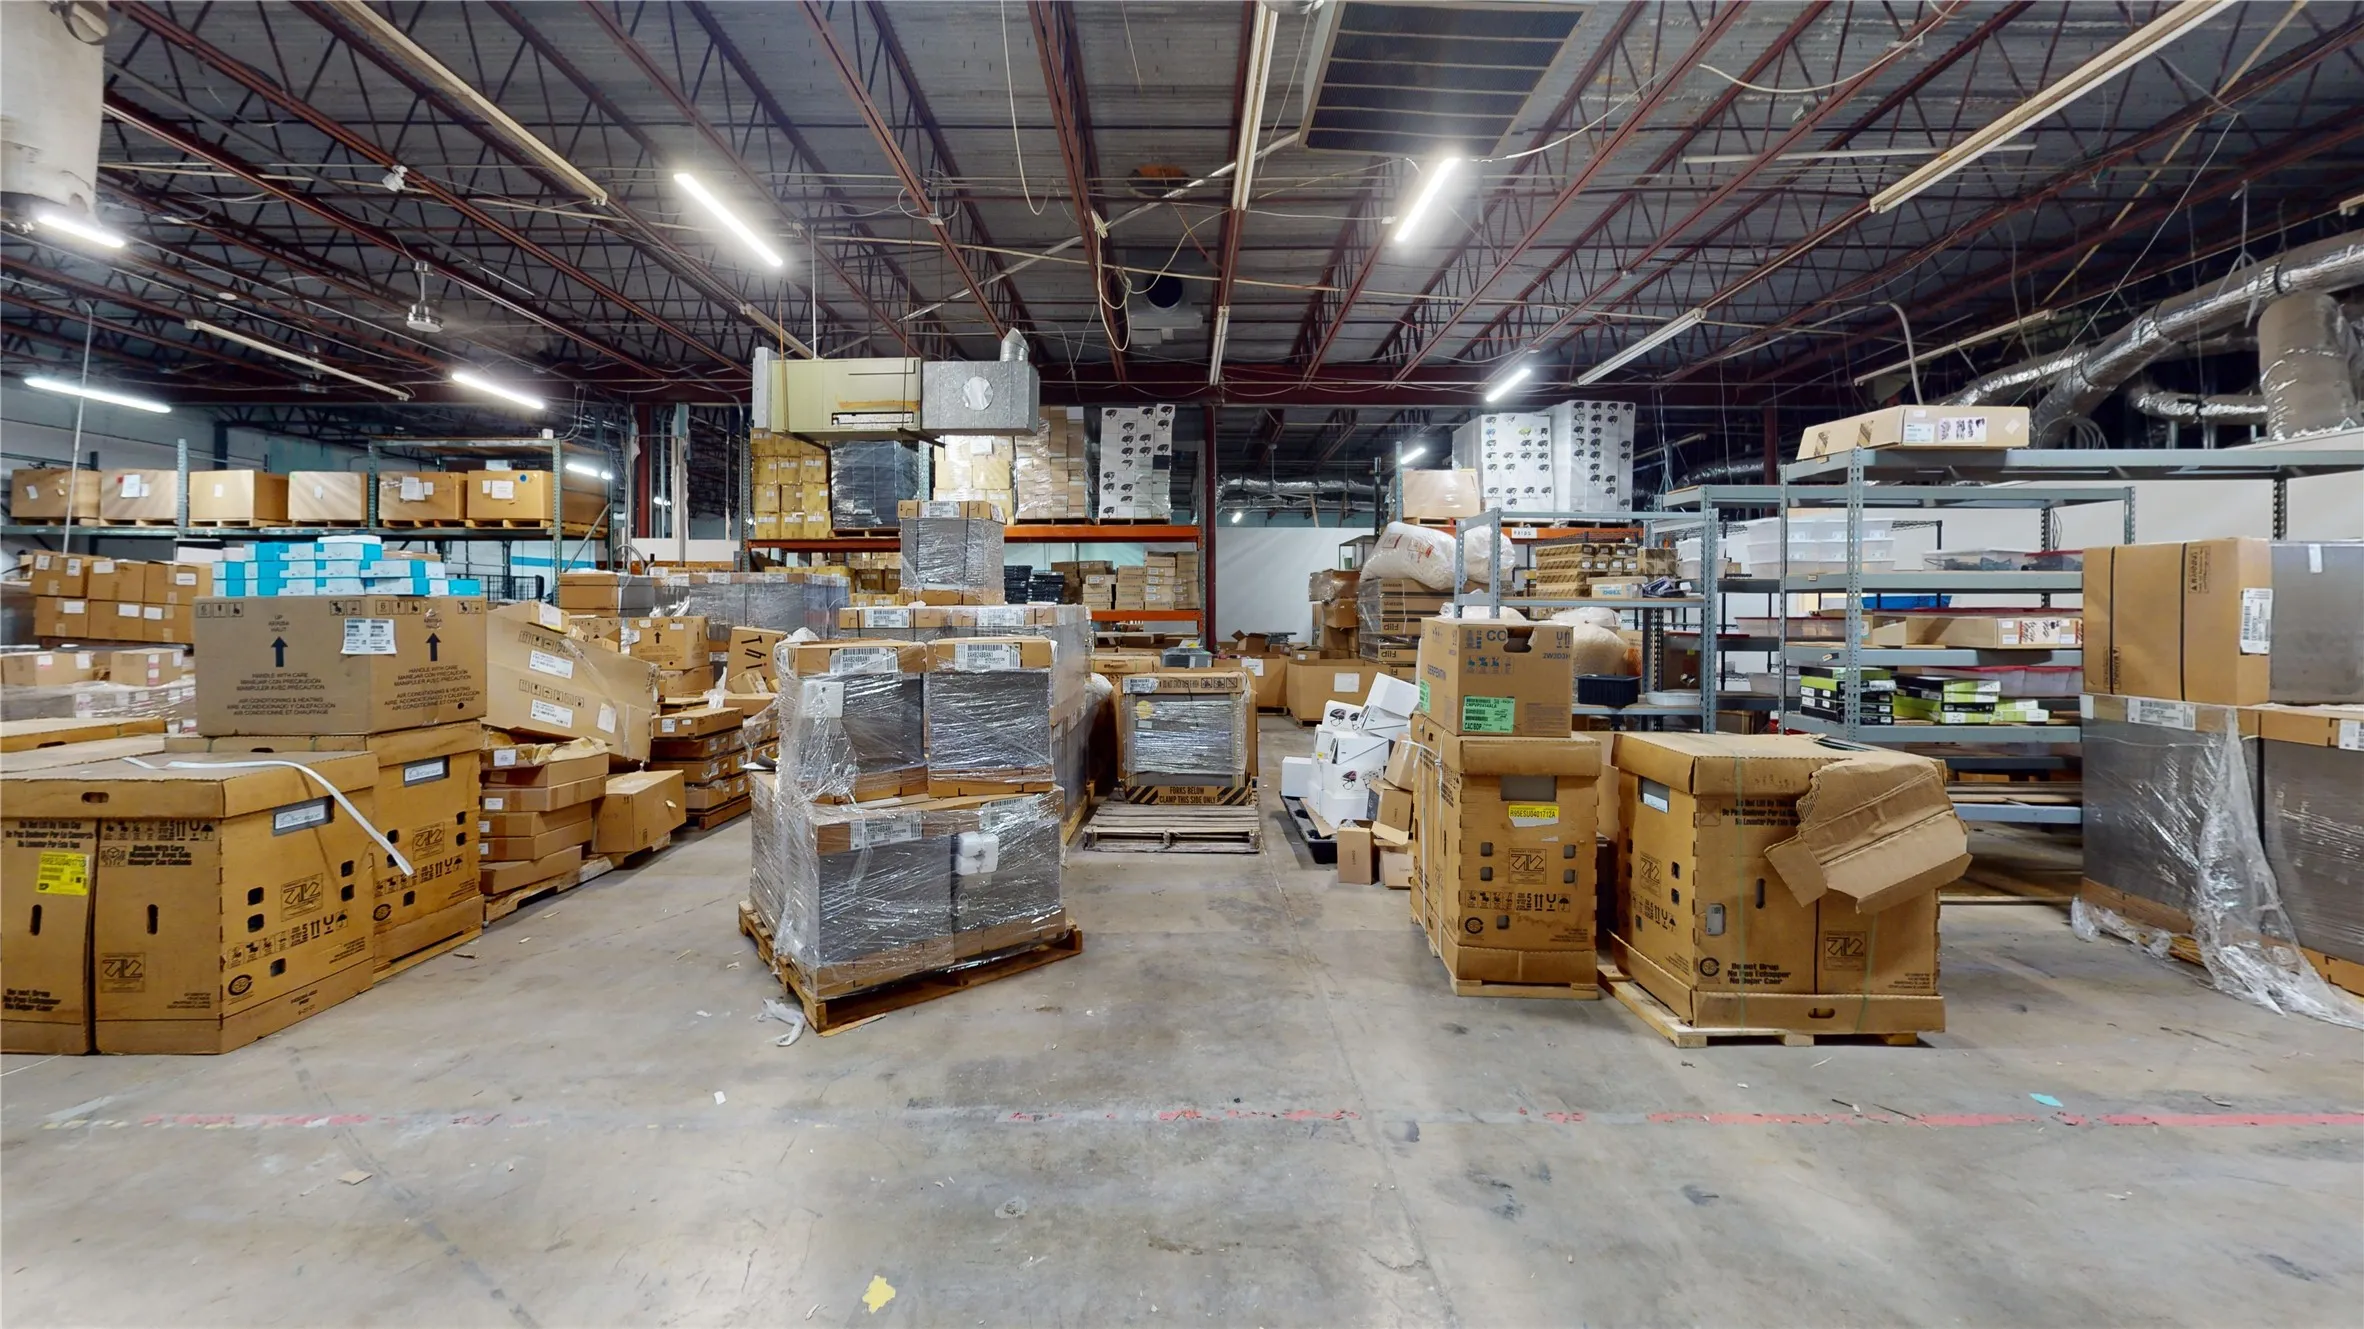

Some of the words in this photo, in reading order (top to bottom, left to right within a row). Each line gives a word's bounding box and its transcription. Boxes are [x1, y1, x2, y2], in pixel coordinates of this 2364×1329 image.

[1170, 786, 1187, 794] FORKS
[1187, 786, 1205, 795] BELOW
[1160, 795, 1177, 803] CLAMP
[1178, 795, 1190, 803] THIS
[1190, 795, 1202, 803] SIDE
[1203, 795, 1216, 804] ONLY
